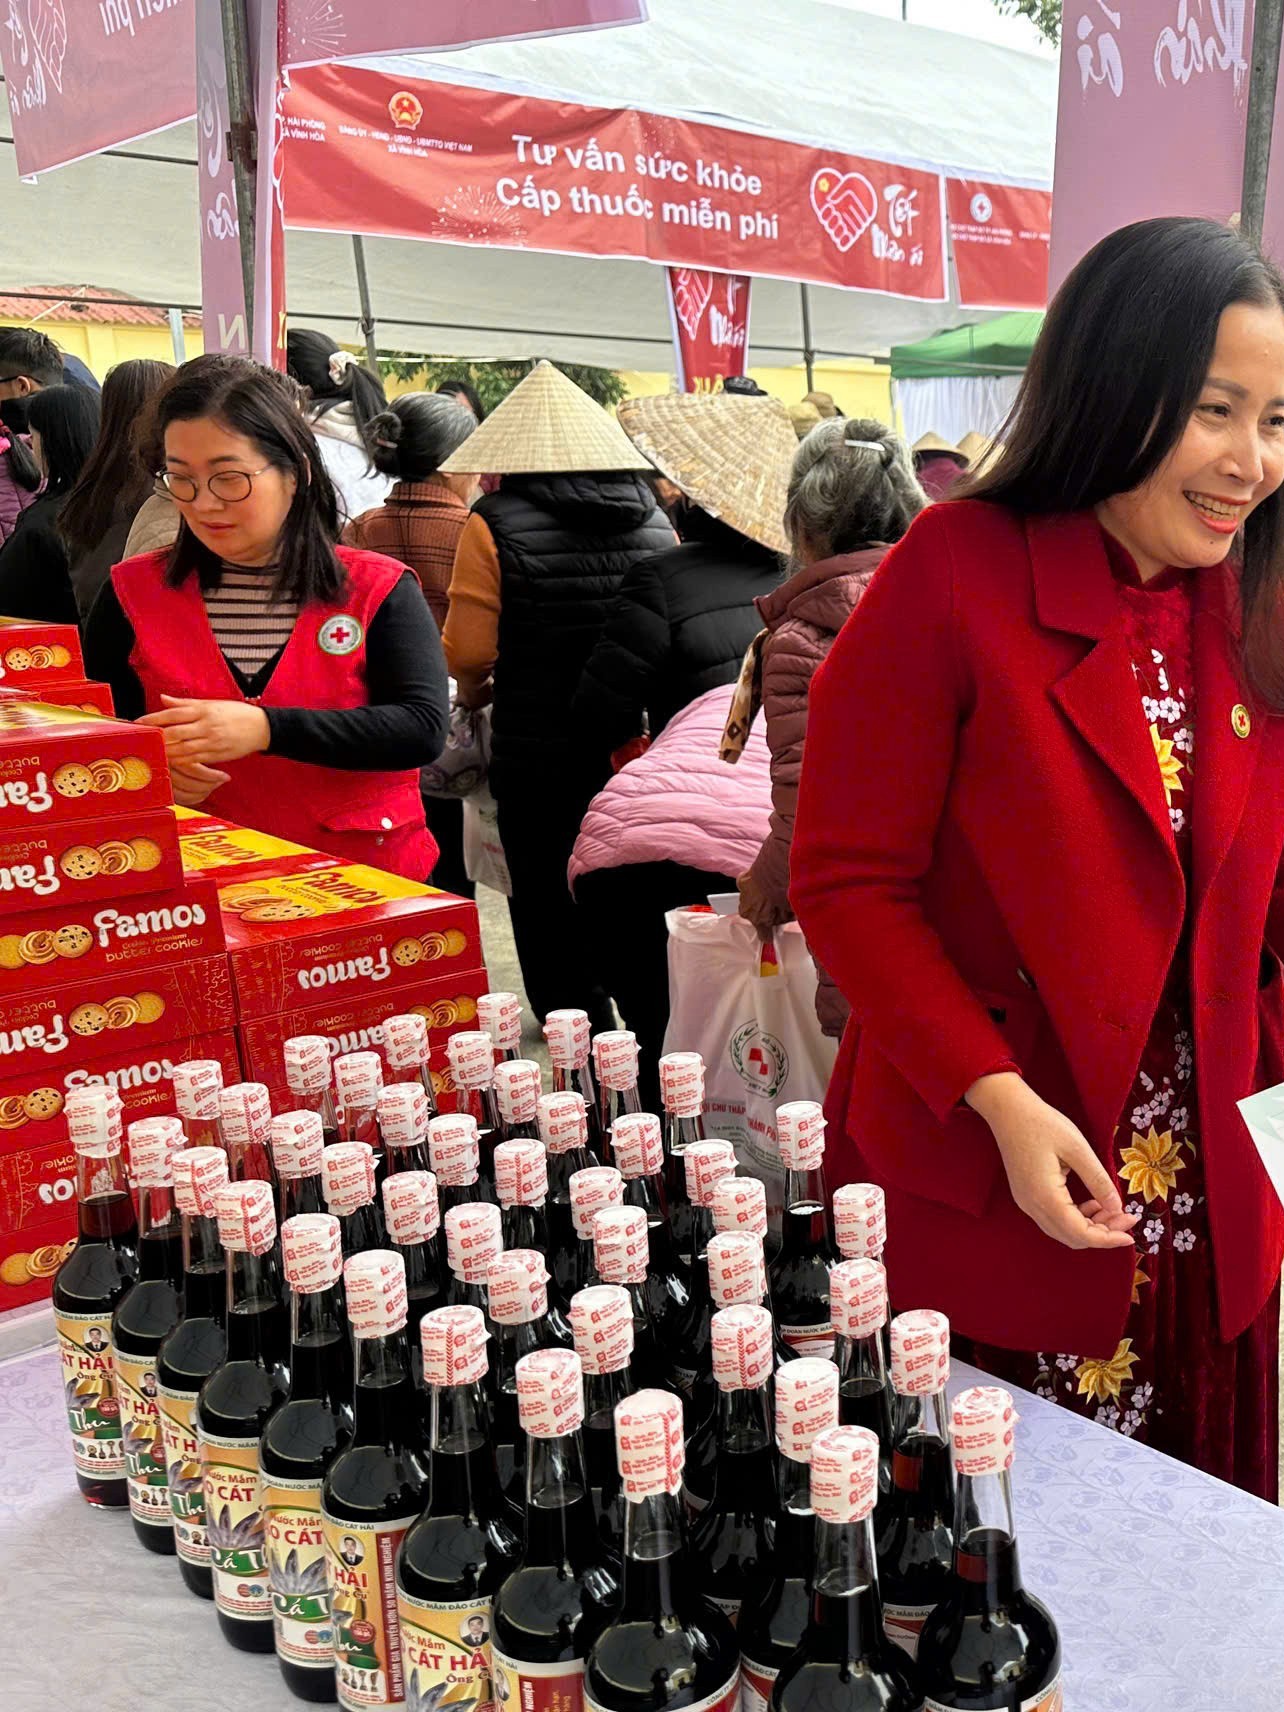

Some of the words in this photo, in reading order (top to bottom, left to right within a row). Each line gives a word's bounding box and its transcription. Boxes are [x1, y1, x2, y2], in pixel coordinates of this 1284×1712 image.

[512, 134, 556, 165] Tư
[563, 138, 625, 173] vấn
[635, 151, 689, 183] sức
[696, 158, 762, 196] khỏe
[496, 175, 561, 216] Cấp
[569, 184, 653, 220] thuốc
[662, 197, 731, 233] miễn
[739, 213, 779, 241] phí
[883, 184, 921, 238] Tết
[79, 1353, 114, 1370] HẢI
[133, 1397, 159, 1416] HẢ
[228, 1474, 257, 1484] Mắm
[218, 1484, 255, 1502] CÁT
[285, 1527, 324, 1546] CÁT
[334, 1565, 367, 1587] HẢI
[383, 1565, 394, 1581] KINH
[384, 1583, 396, 1598] NĂM
[426, 1602, 447, 1611] MẮM
[448, 1601, 469, 1611] ĐẢO
[470, 1599, 486, 1609] CÁT
[417, 1635, 446, 1651] Mắm
[391, 1650, 401, 1662] GIA
[408, 1646, 443, 1671] CÁT
[450, 1647, 488, 1672] HẢ
[445, 1673, 474, 1685] Ông
